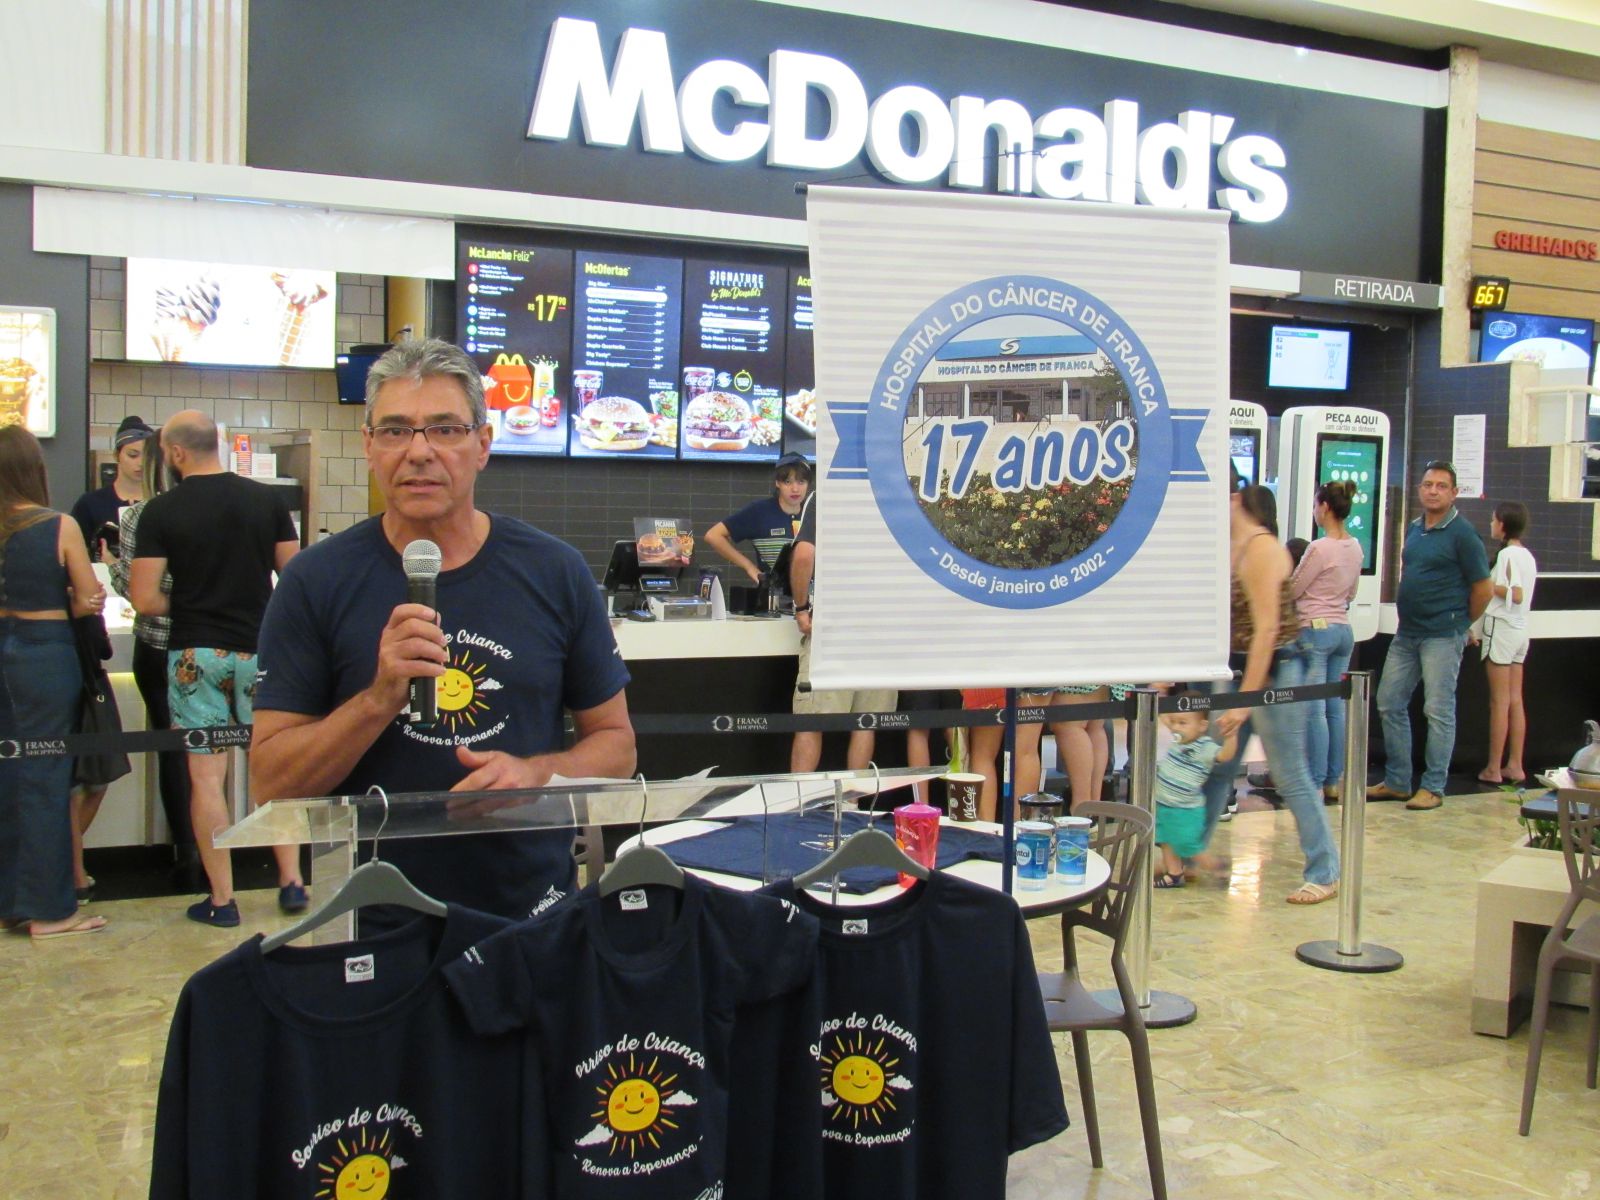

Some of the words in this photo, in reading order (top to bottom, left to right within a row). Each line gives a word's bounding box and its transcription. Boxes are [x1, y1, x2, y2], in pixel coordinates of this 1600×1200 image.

[526, 17, 1288, 223] McDonald's
[469, 246, 512, 260] McLanche
[1494, 230, 1598, 261] GRELHADOS
[585, 262, 629, 276] McOfertas
[709, 270, 764, 283] SIGNATURE
[1334, 278, 1415, 303] RETIRADA
[1475, 286, 1504, 305] 667
[880, 317, 952, 411] HOSPITAL
[950, 295, 983, 323] DO
[987, 282, 1078, 315] CÂNCER
[1078, 304, 1111, 336] DE
[1105, 327, 1159, 418] FRANCA
[938, 365, 982, 376] HOSPITAL
[984, 364, 997, 374] DO
[1000, 361, 1037, 373] CÂNCER
[1040, 362, 1052, 371] DE
[1054, 360, 1095, 371] FRANCA
[1230, 407, 1255, 418] AQUI
[1325, 412, 1351, 425] PEÇA
[1354, 414, 1378, 425] AQUI
[920, 420, 989, 502] 17
[992, 419, 1133, 493] anos
[939, 551, 987, 588] Desde
[988, 576, 1046, 594] janeiro
[1049, 575, 1069, 589] de
[1070, 552, 1107, 583] 2002
[457, 629, 513, 660] Criança
[736, 717, 768, 725] FRANCA
[1017, 708, 1045, 716] FRANCA
[25, 740, 66, 750] FRANCA
[212, 729, 250, 739] FRANCA
[403, 724, 444, 745] Renova
[454, 721, 505, 747] Esperança
[963, 785, 977, 819] McCafé
[845, 1011, 868, 1028] de
[872, 1014, 918, 1053] Crianç
[575, 1043, 614, 1078] orriso
[616, 1033, 640, 1053] de
[644, 1032, 705, 1070] Criança
[348, 1106, 371, 1128] de
[822, 1129, 843, 1141] ova
[844, 1134, 853, 1143] a
[854, 1127, 911, 1148] Esperança
[581, 1158, 621, 1176] Renova
[622, 1166, 631, 1175] a
[633, 1143, 698, 1175] Esperança
